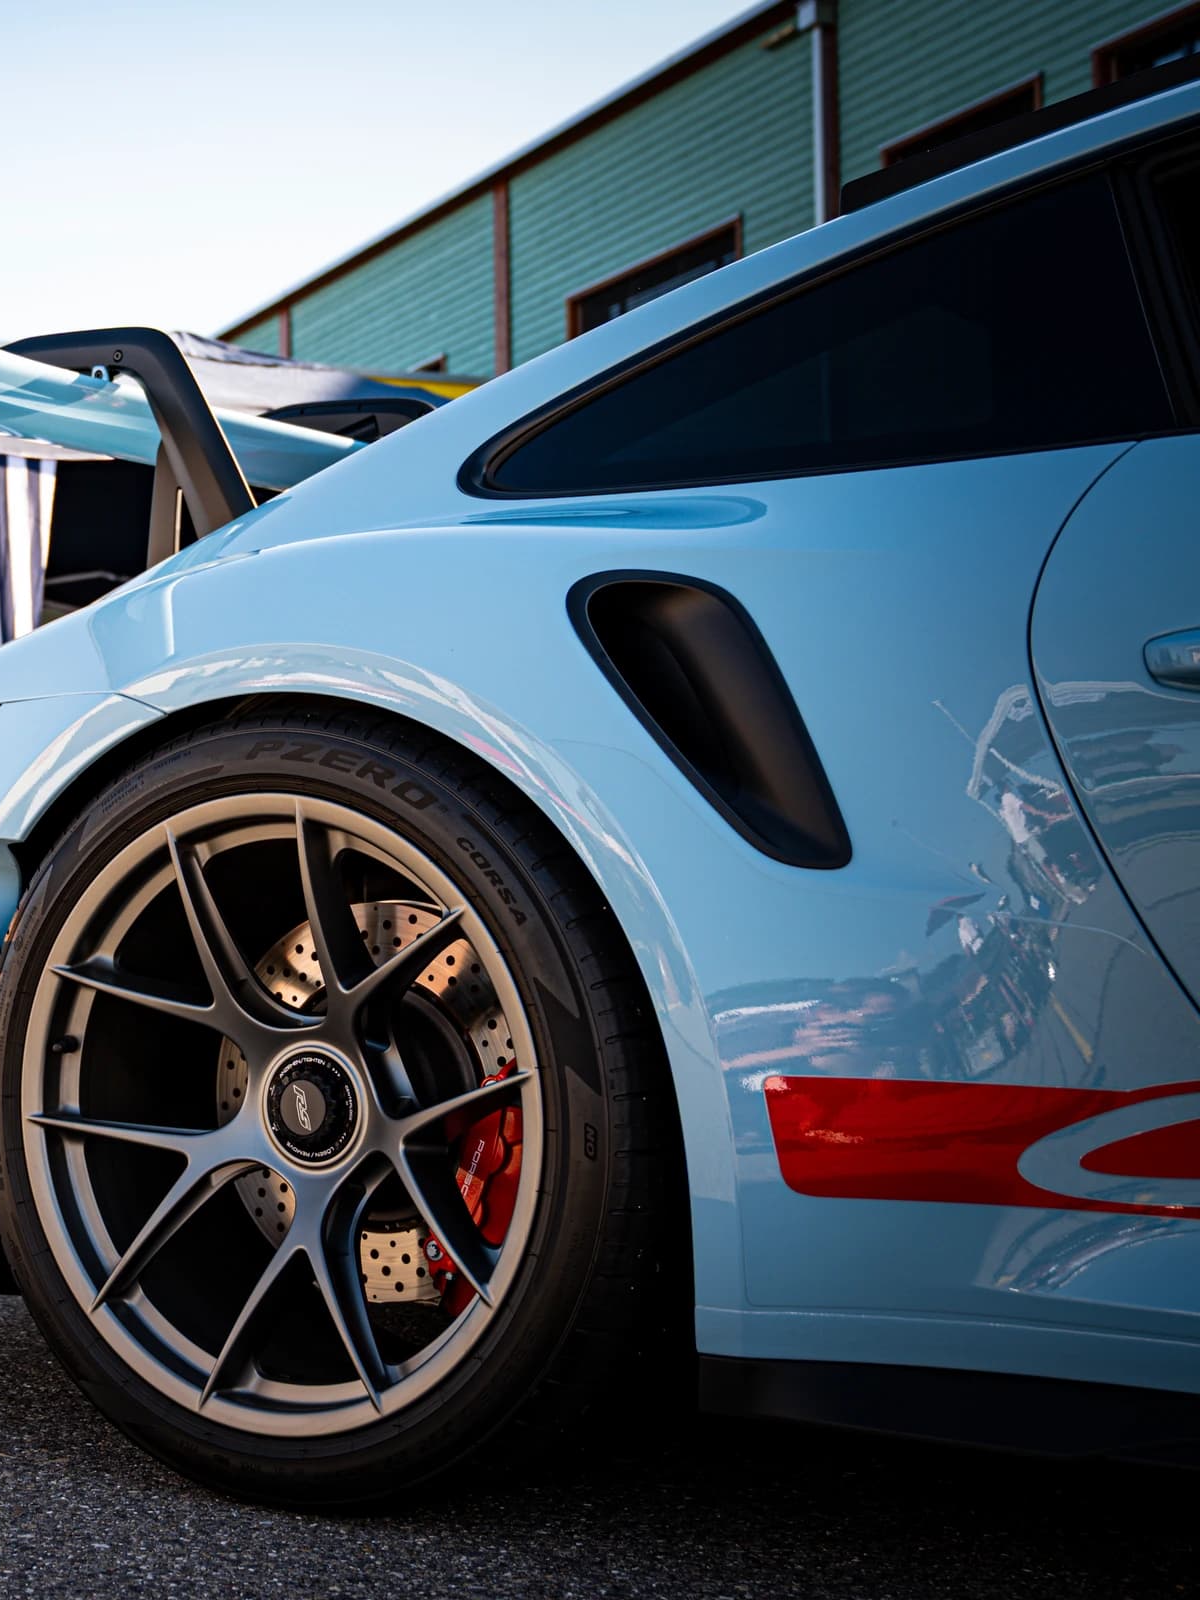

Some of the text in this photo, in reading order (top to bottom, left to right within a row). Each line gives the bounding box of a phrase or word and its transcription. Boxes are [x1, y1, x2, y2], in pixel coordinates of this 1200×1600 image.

[456, 836, 529, 927] CORSA
[292, 1084, 312, 1131] RS
[460, 1139, 485, 1198] PORSC
